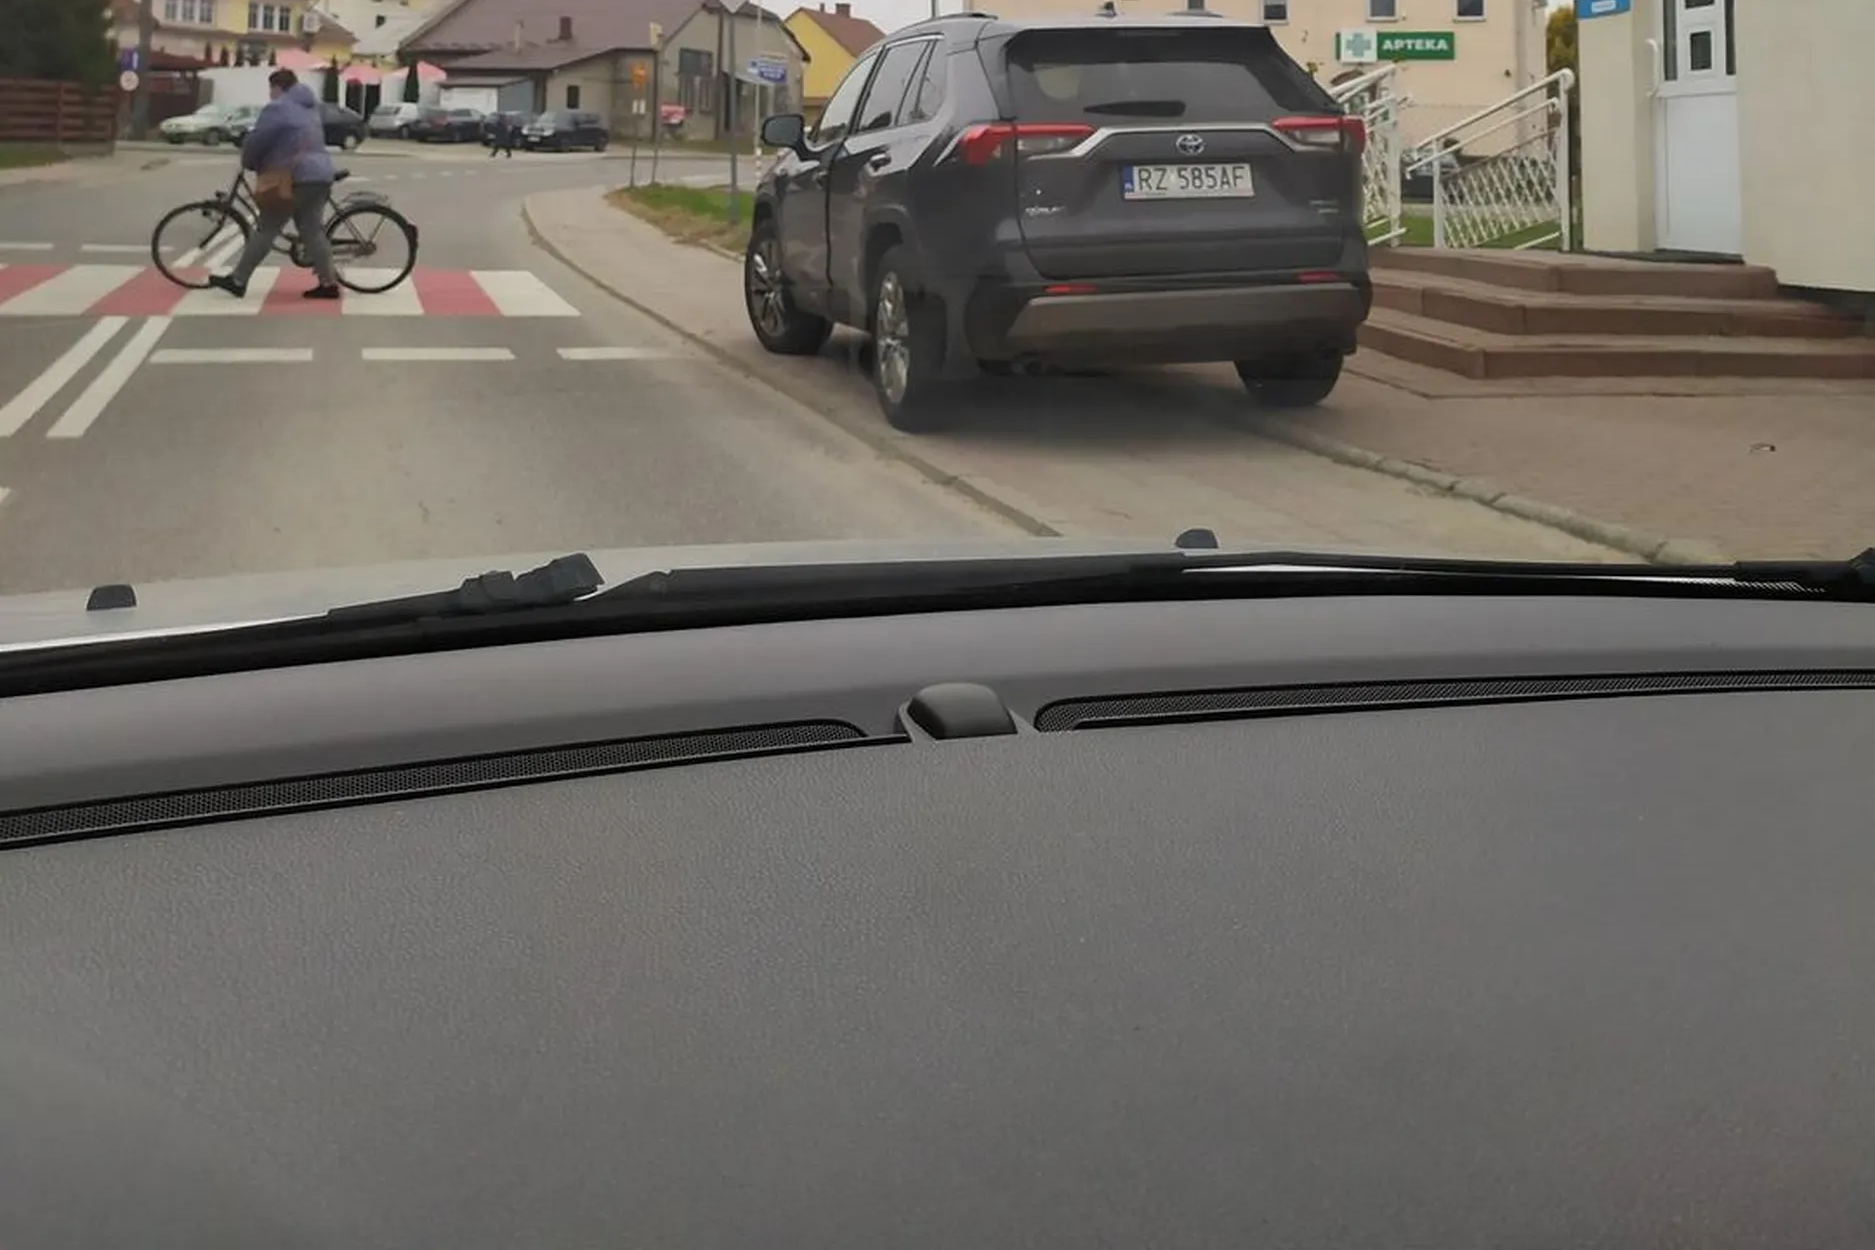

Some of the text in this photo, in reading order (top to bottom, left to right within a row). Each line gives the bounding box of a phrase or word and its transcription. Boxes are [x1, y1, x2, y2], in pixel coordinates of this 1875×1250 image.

[1382, 38, 1449, 51] APTEKA
[1138, 165, 1245, 191] RZ 585AF
